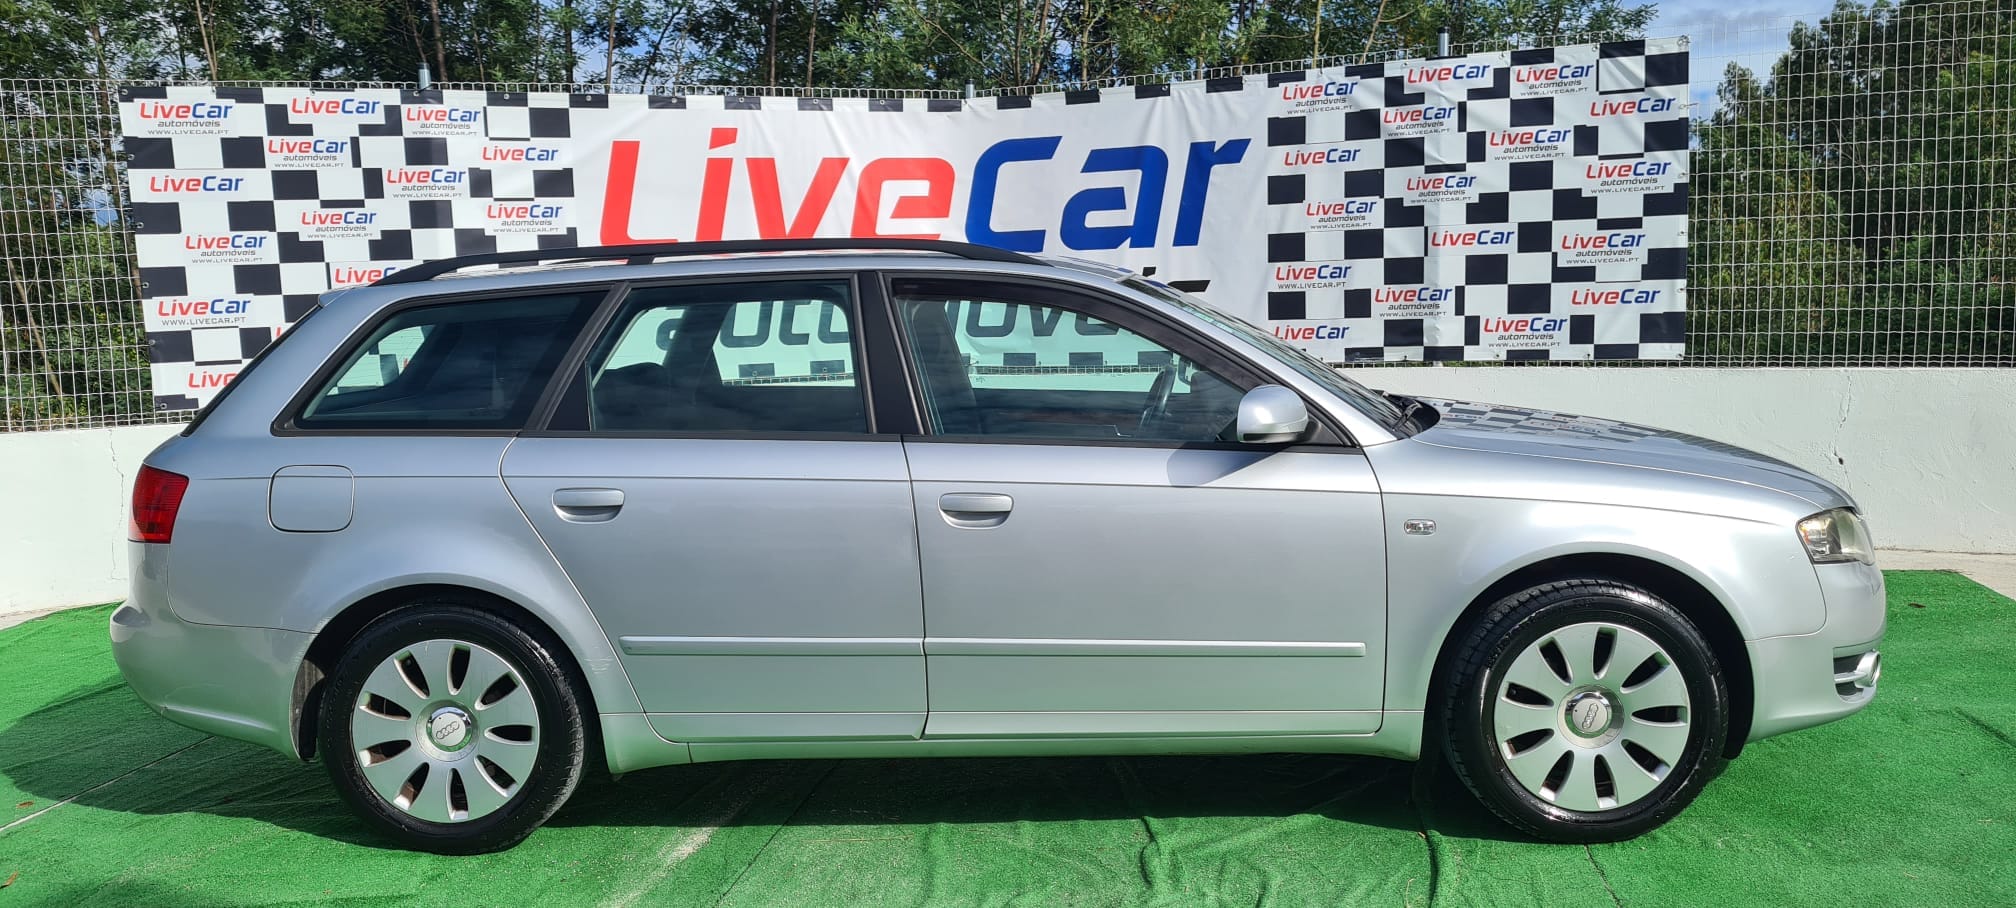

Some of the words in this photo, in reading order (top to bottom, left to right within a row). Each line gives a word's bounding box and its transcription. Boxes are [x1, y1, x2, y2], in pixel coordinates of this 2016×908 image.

[1408, 65, 1490, 83] LiveCar
[1516, 64, 1594, 82] LiveCar
[1283, 82, 1358, 100] LiveCar
[1529, 80, 1581, 89] automóveis
[291, 97, 380, 116] LiveCar
[1296, 97, 1346, 107] automóveis
[1591, 97, 1676, 117] LiveCar
[140, 102, 233, 119] LiveCar
[406, 106, 480, 122] LiveCar
[1384, 107, 1455, 124] LiveCar
[158, 120, 220, 128] automóveis
[1396, 120, 1444, 130] automóveis
[1490, 129, 1571, 146] LiveCar
[268, 139, 348, 154] LiveCar
[482, 146, 558, 161] LiveCar
[1504, 144, 1558, 153] automóveis
[1285, 149, 1361, 166] LiveCar
[387, 168, 466, 183] LiveCar
[1586, 161, 1671, 179] LiveCar
[150, 175, 244, 192] LiveCar
[600, 126, 1251, 252] LiveCar
[1407, 176, 1476, 190] LiveCar
[1600, 177, 1657, 186] automóveis
[1418, 188, 1465, 197] automóveis
[487, 204, 563, 218] LiveCar
[1306, 201, 1377, 216] LiveCar
[301, 211, 377, 225] LiveCar
[185, 234, 267, 250] LiveCar
[1431, 230, 1514, 247] LiveCar
[1562, 234, 1645, 249] LiveCar
[1576, 249, 1632, 257] automóveis
[1276, 265, 1352, 280] LiveCar
[1375, 287, 1452, 303] LiveCar
[1572, 288, 1661, 304] LiveCar
[158, 299, 251, 316] LiveCar
[1484, 317, 1568, 332] LiveCar
[1274, 325, 1350, 340] LiveCar
